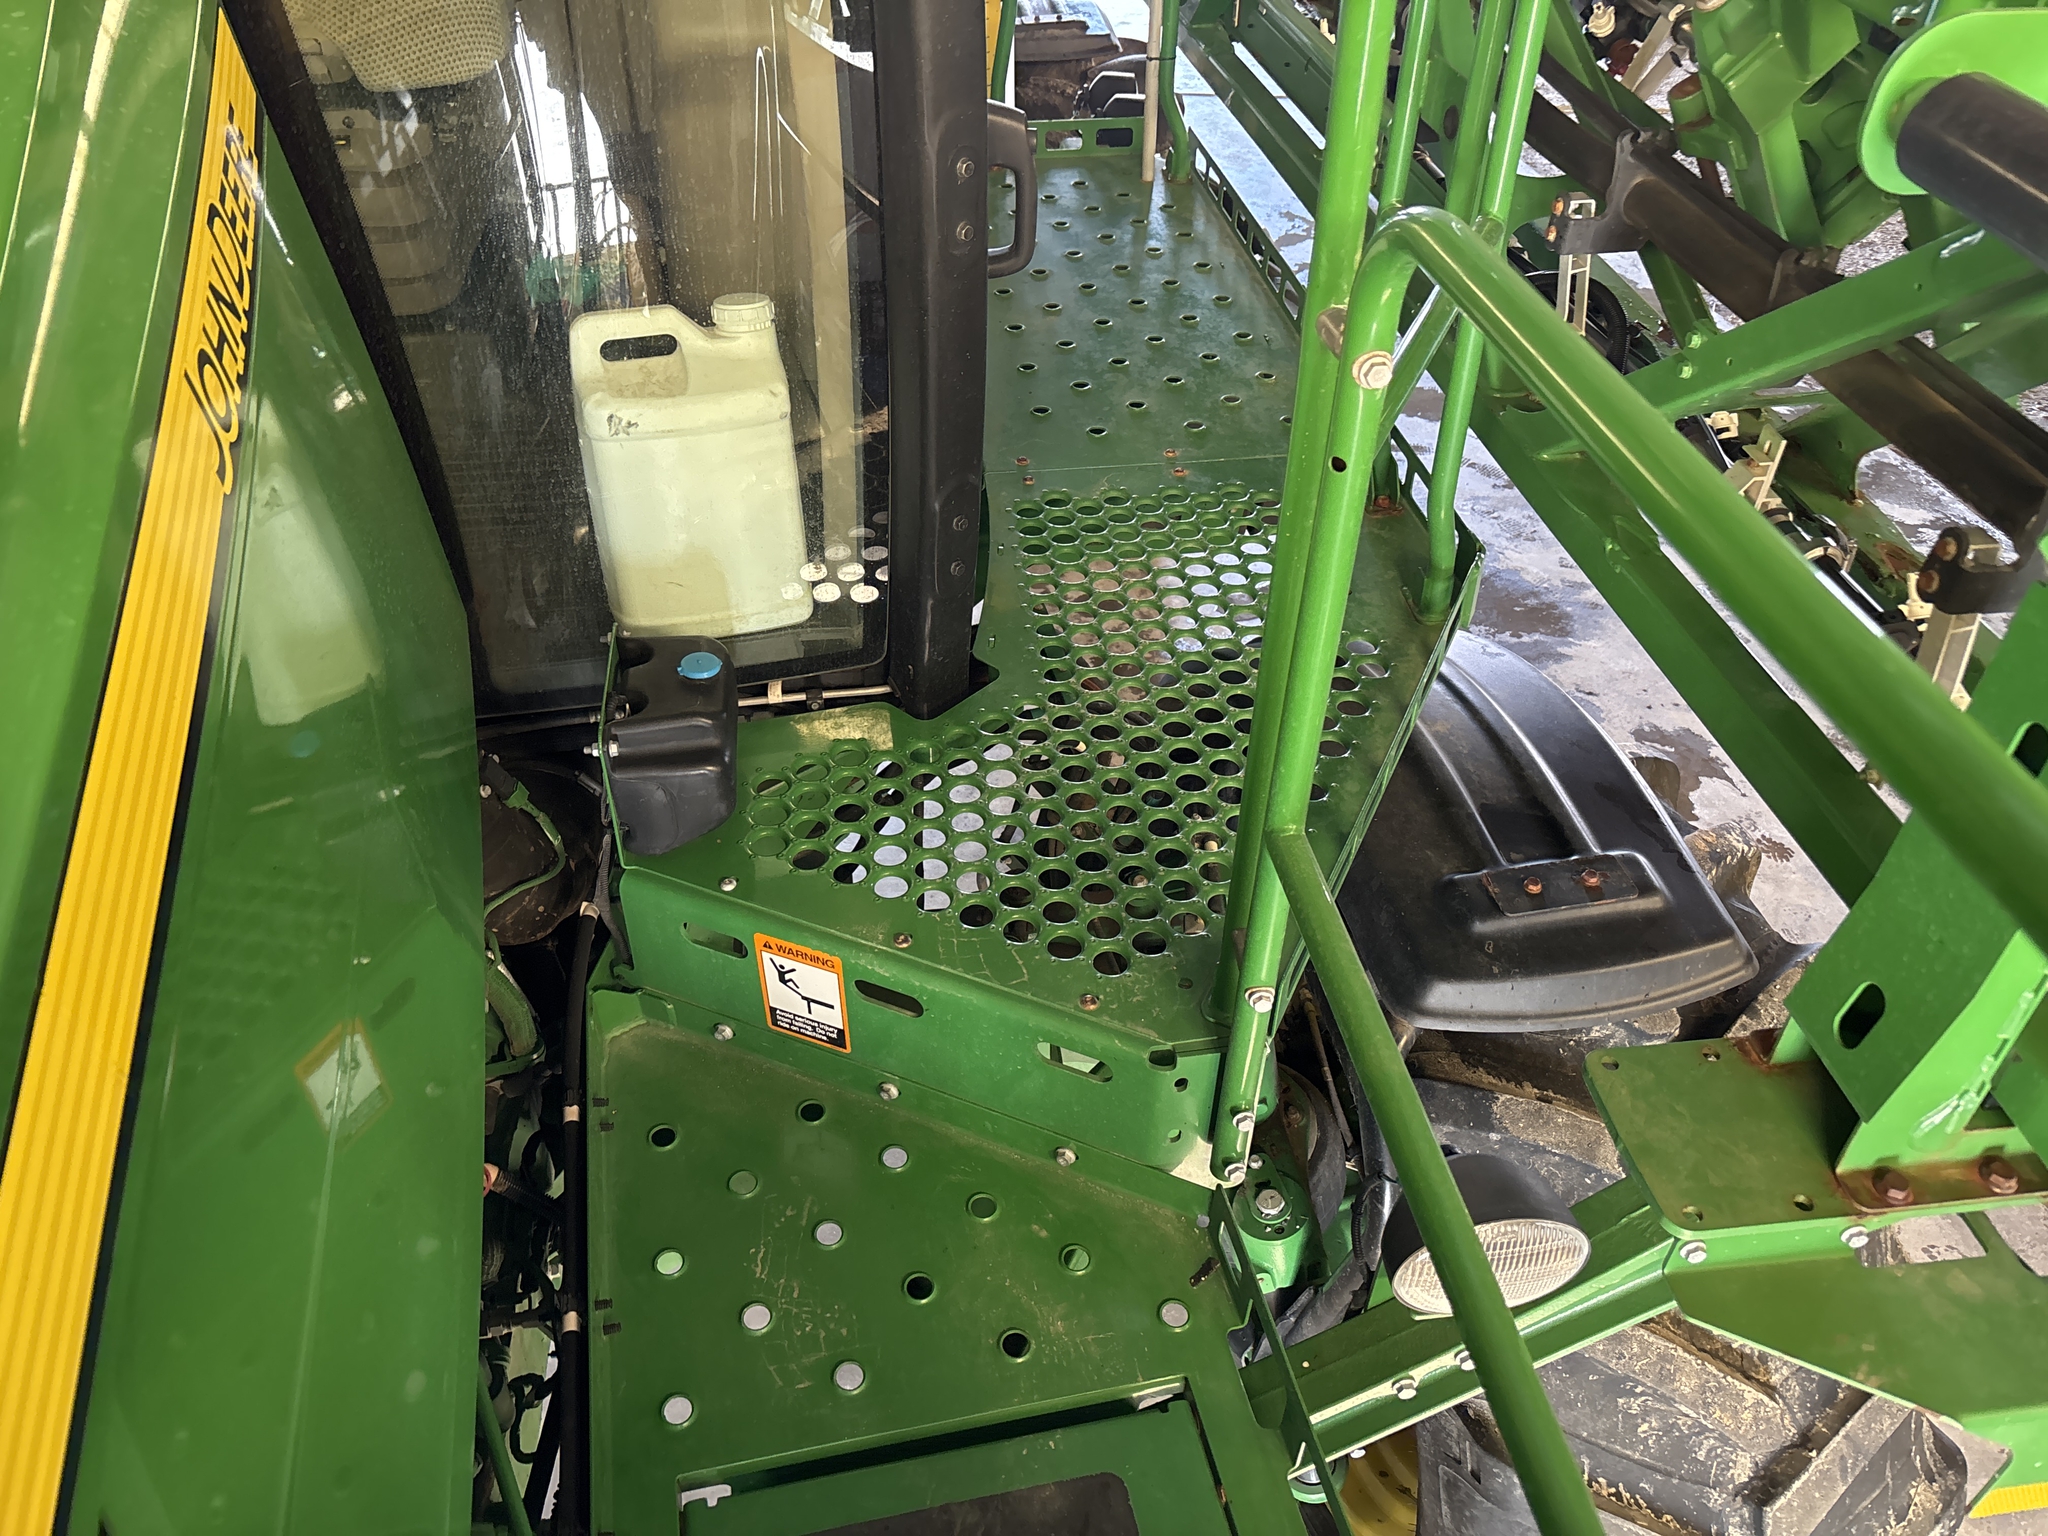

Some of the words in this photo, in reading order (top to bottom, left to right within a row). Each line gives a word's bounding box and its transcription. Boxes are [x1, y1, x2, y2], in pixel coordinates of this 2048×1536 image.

[207, 100, 254, 301] DEERE
[184, 256, 246, 489] JOHN
[775, 943, 835, 969] WARNING
[776, 1009, 794, 1019] Avoid
[795, 1016, 819, 1027] serious
[820, 1022, 838, 1034] injury
[776, 1015, 791, 1024] from
[792, 1019, 813, 1031] falling.
[815, 1027, 825, 1035] Do
[826, 1030, 838, 1039] not
[777, 1021, 790, 1029] ride
[800, 1028, 829, 1041] machine.
